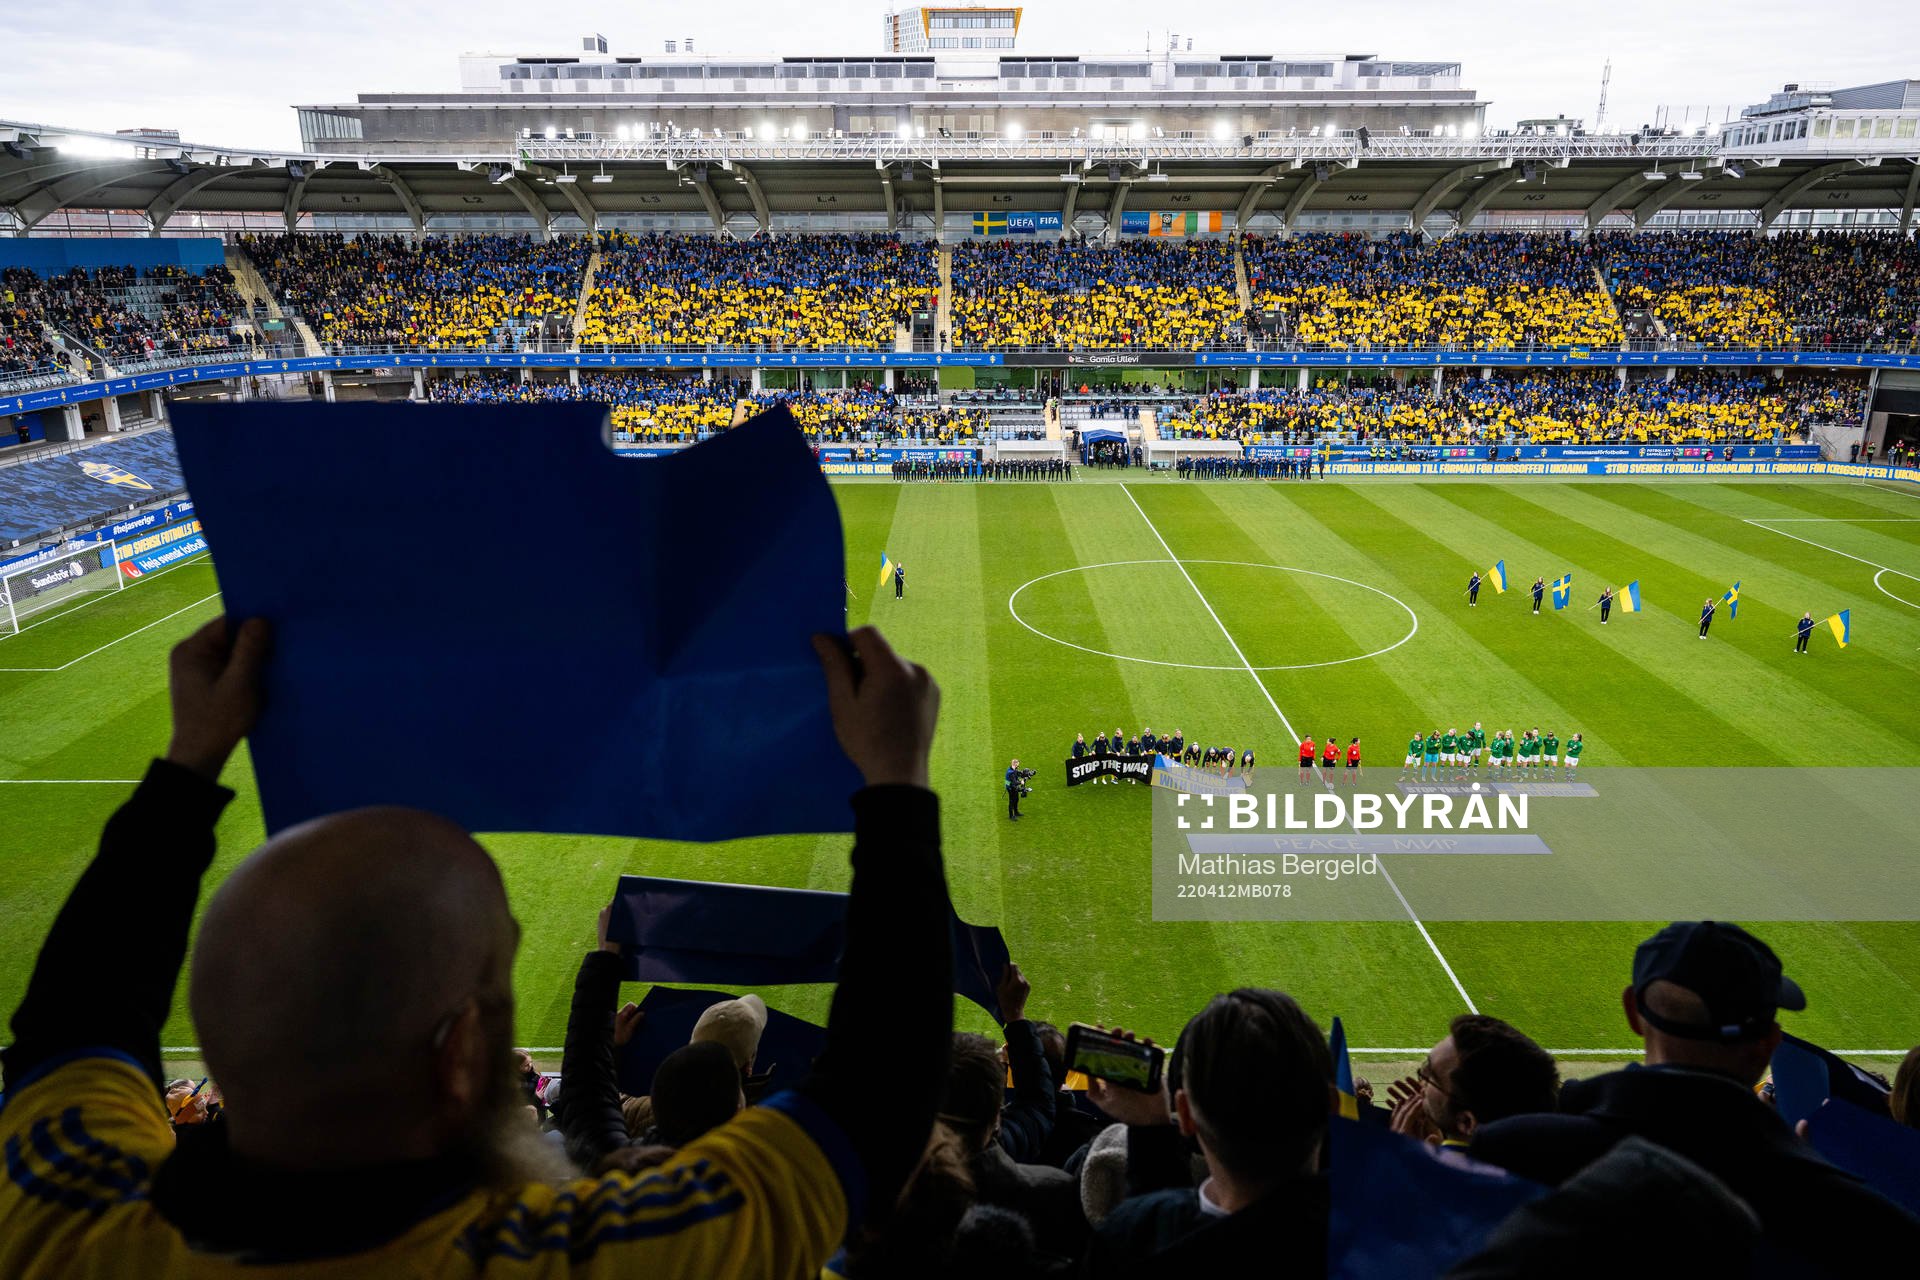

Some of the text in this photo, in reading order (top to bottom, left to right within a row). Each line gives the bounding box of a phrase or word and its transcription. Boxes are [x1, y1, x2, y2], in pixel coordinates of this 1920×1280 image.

[1009, 218, 1034, 228] UEFA
[1039, 216, 1059, 226] FIFA
[1089, 355, 1115, 363] Gamla
[1116, 355, 1139, 363] Ullevi
[1422, 463, 1439, 474] TILL
[1755, 463, 1771, 474] TILL
[1072, 760, 1149, 778] STOP THE WAR
[1273, 838, 1365, 849] PEACE
